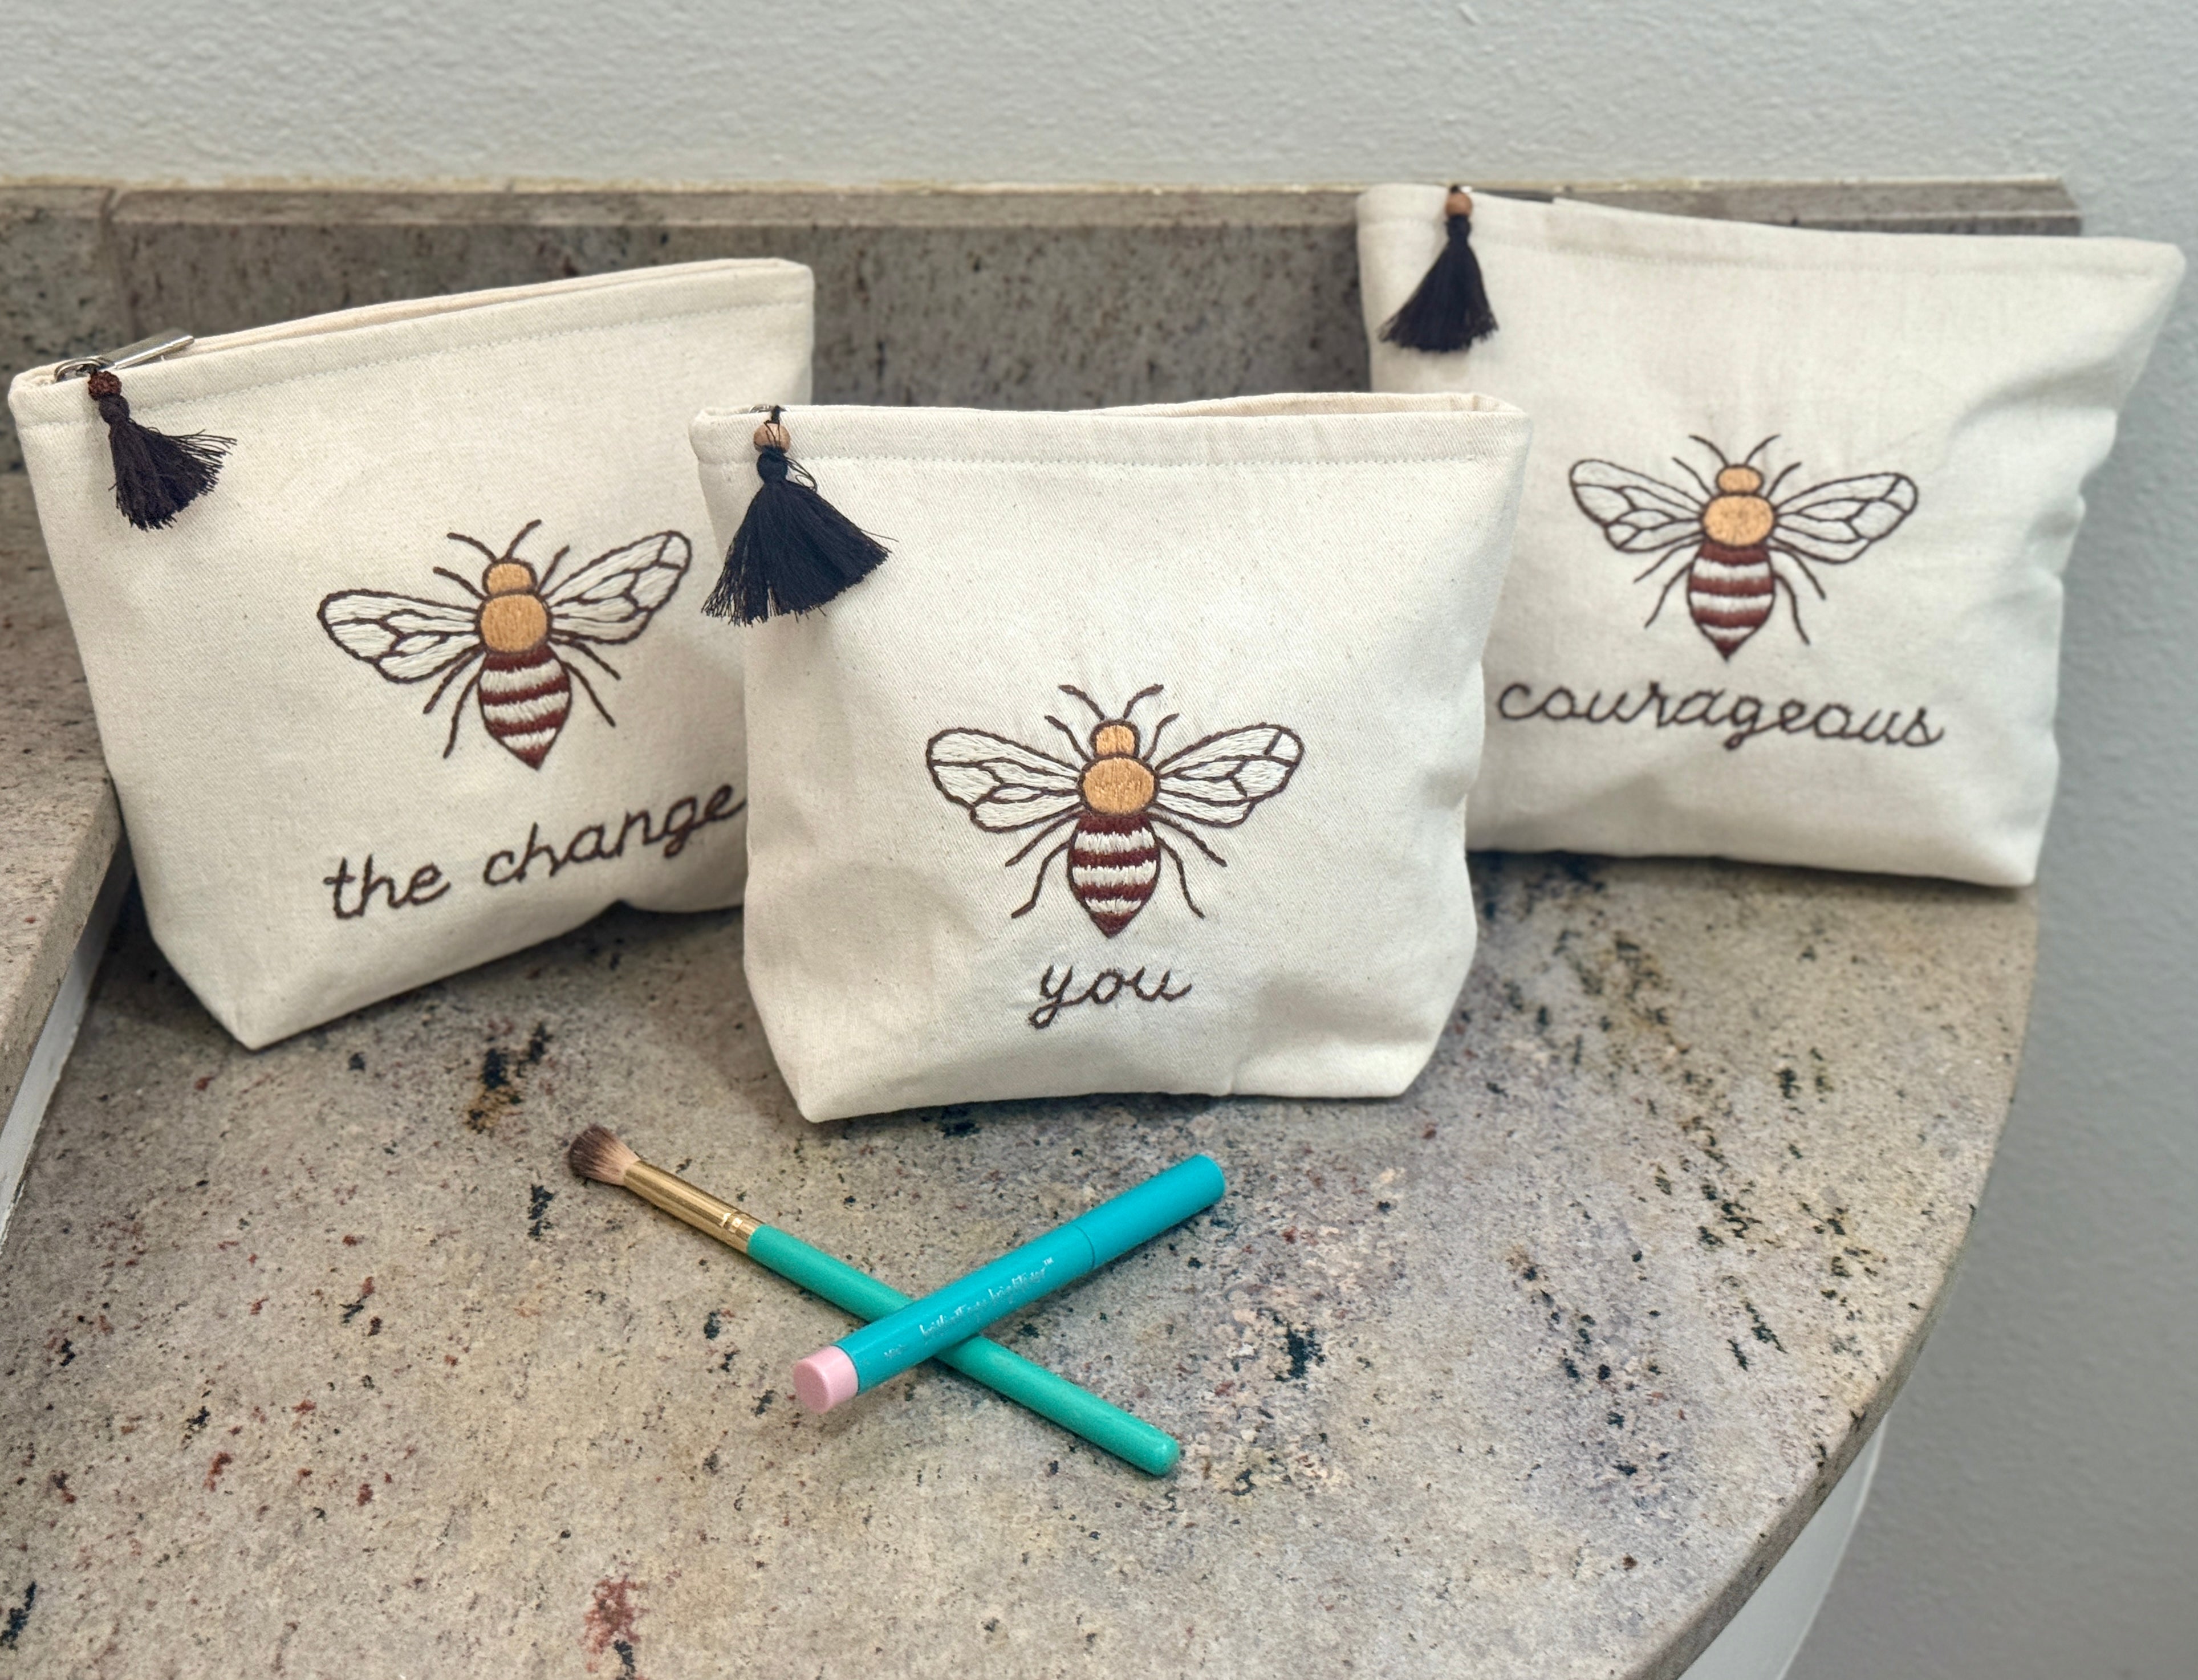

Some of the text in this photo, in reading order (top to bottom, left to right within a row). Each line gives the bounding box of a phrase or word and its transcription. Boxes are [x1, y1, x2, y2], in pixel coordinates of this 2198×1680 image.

[1497, 681, 1945, 751] courageous
[323, 783, 749, 919] the change
[1028, 965, 1193, 1030] you
